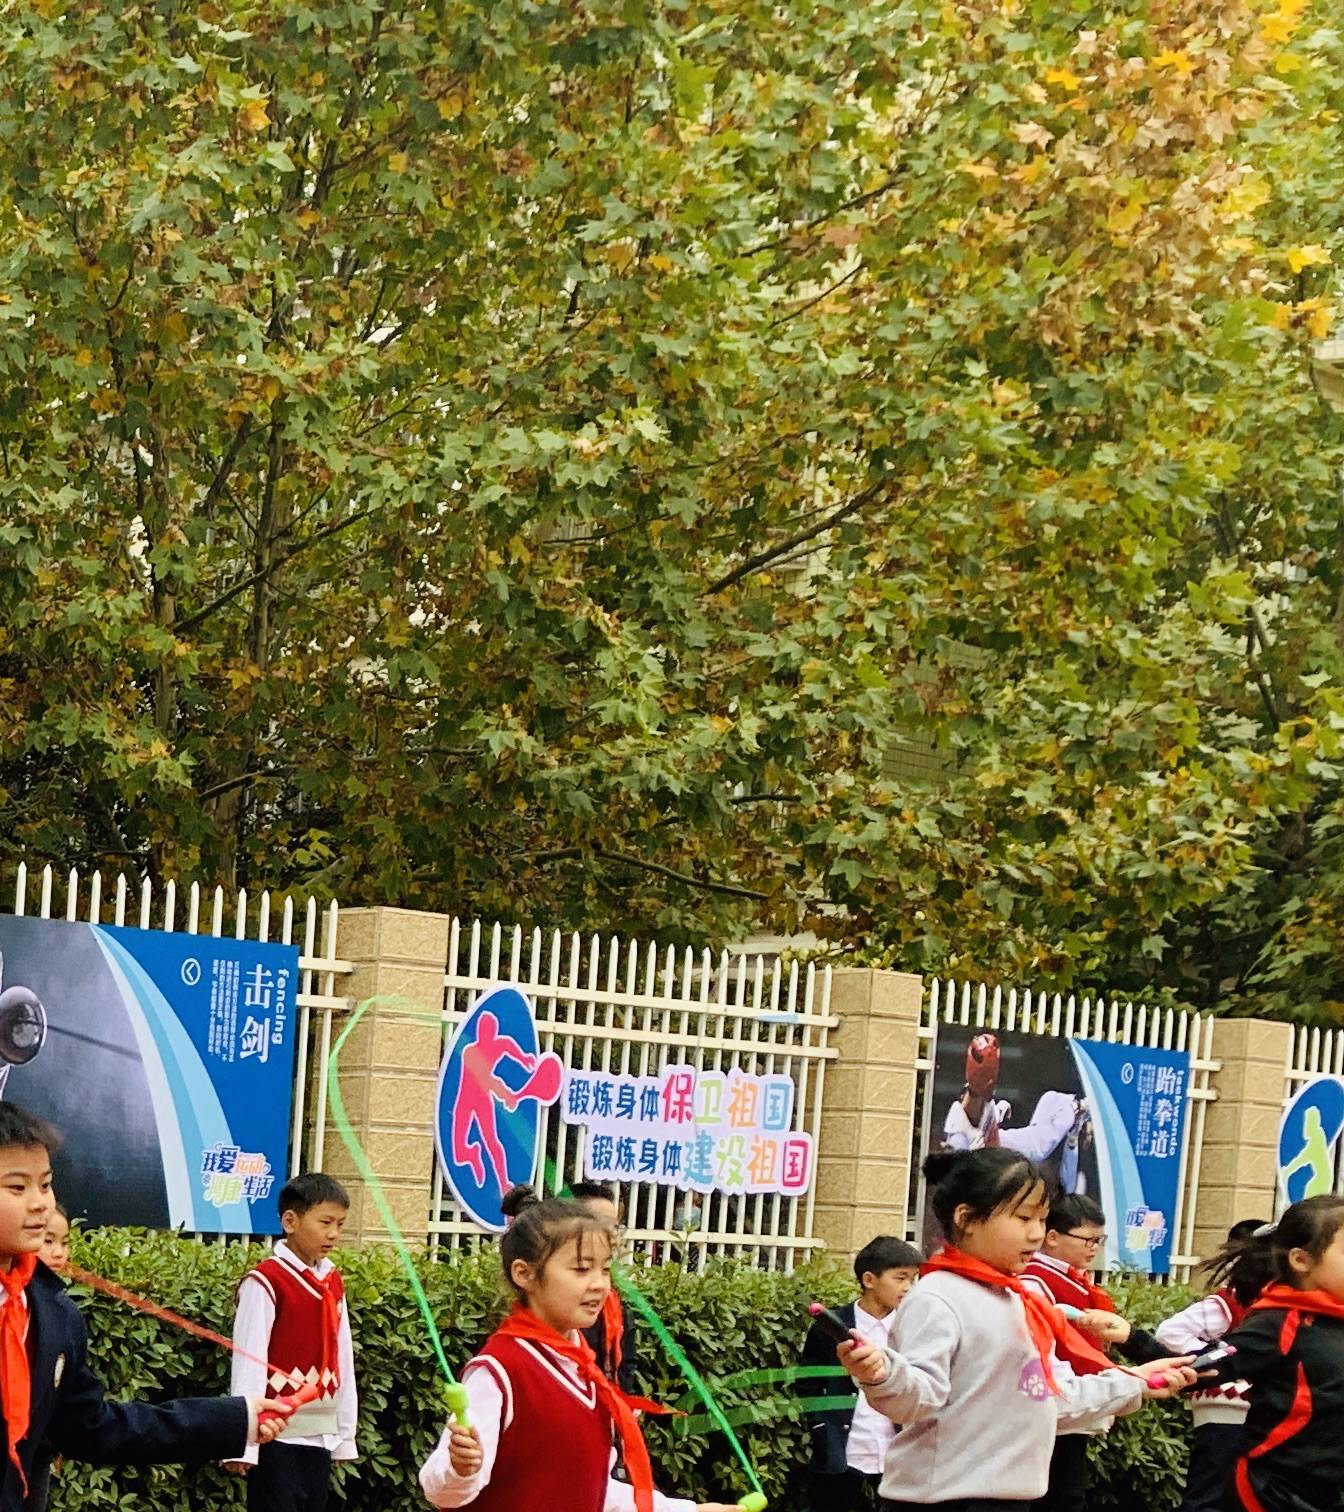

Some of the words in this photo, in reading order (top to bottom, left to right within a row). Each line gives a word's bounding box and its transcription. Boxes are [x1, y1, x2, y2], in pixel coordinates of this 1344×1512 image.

[239, 964, 274, 1063] 击剑
[272, 969, 289, 1044] fencing
[568, 1074, 792, 1131] 锻炼身体保卫祖国
[1149, 1066, 1176, 1158] 跆拳道
[592, 1130, 809, 1188] 锻炼身体建设祖国
